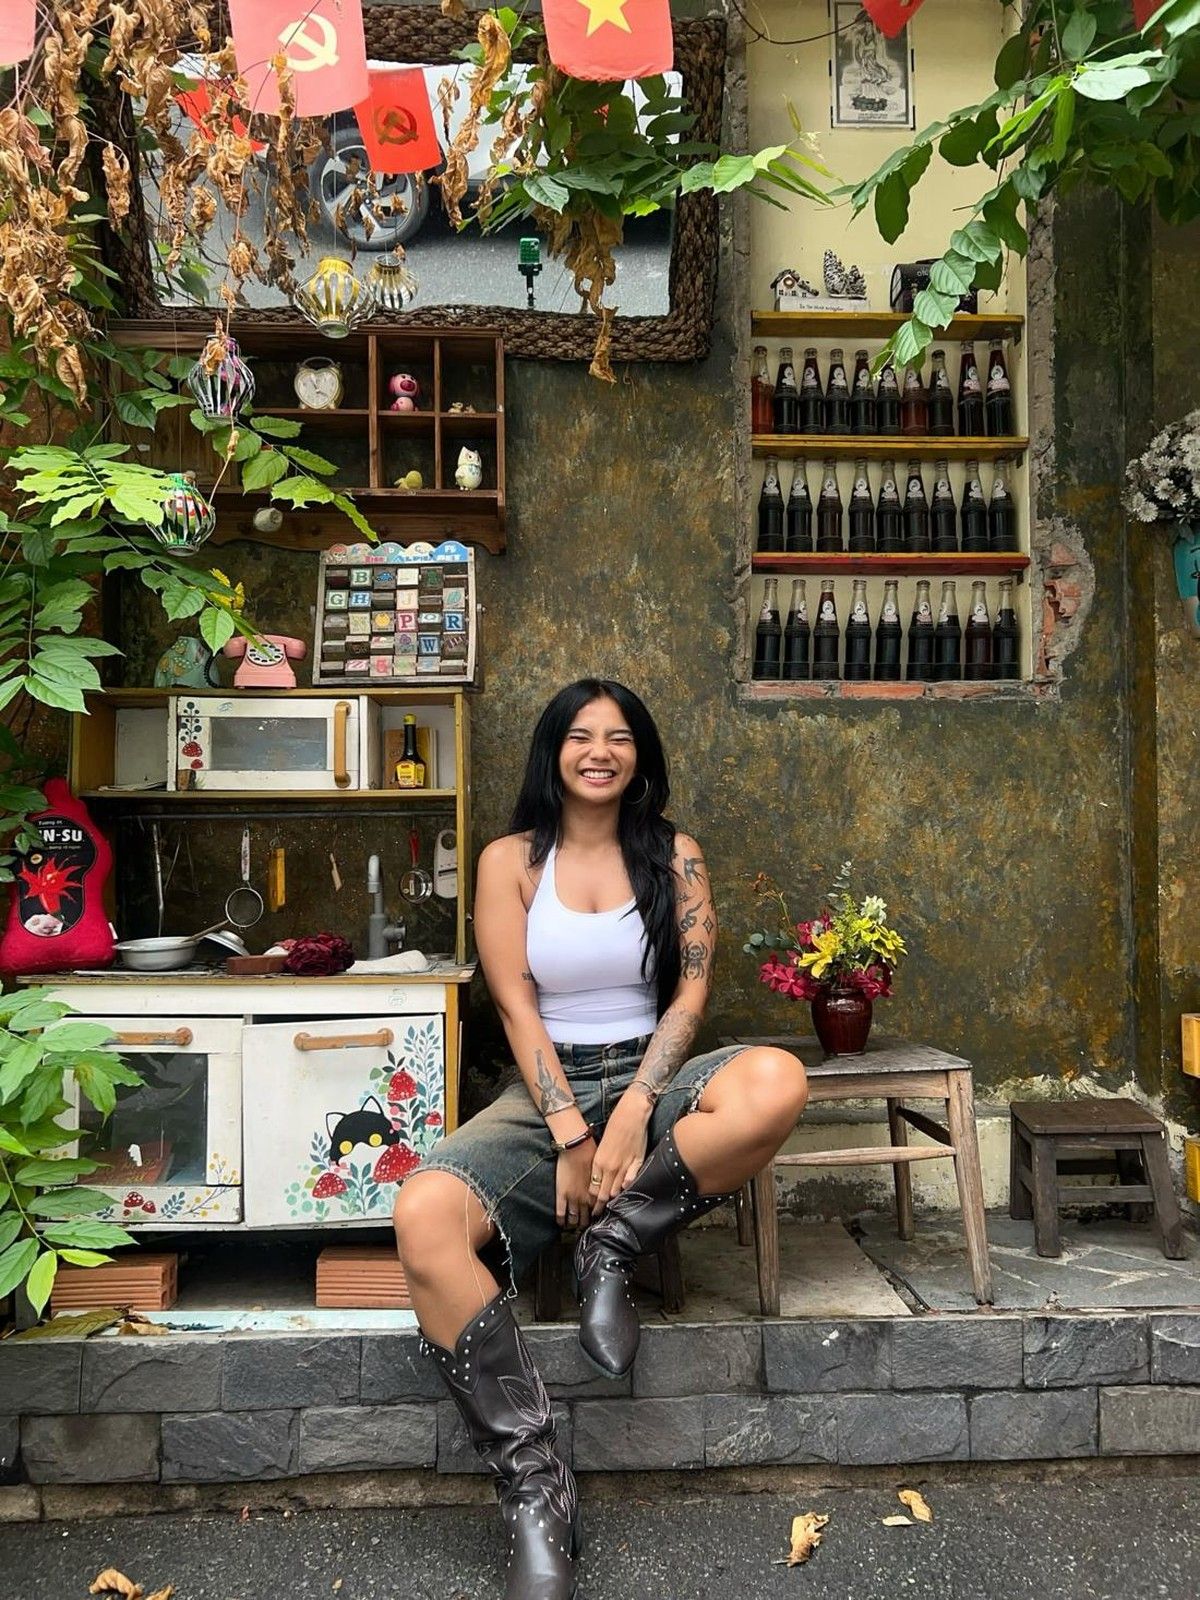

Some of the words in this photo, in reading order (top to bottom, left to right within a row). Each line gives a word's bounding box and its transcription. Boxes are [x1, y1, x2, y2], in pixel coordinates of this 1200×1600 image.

[355, 571, 368, 583] B
[330, 593, 343, 606] G
[353, 594, 367, 604] H
[400, 614, 413, 629] P
[447, 615, 461, 629] R
[422, 638, 436, 652] W
